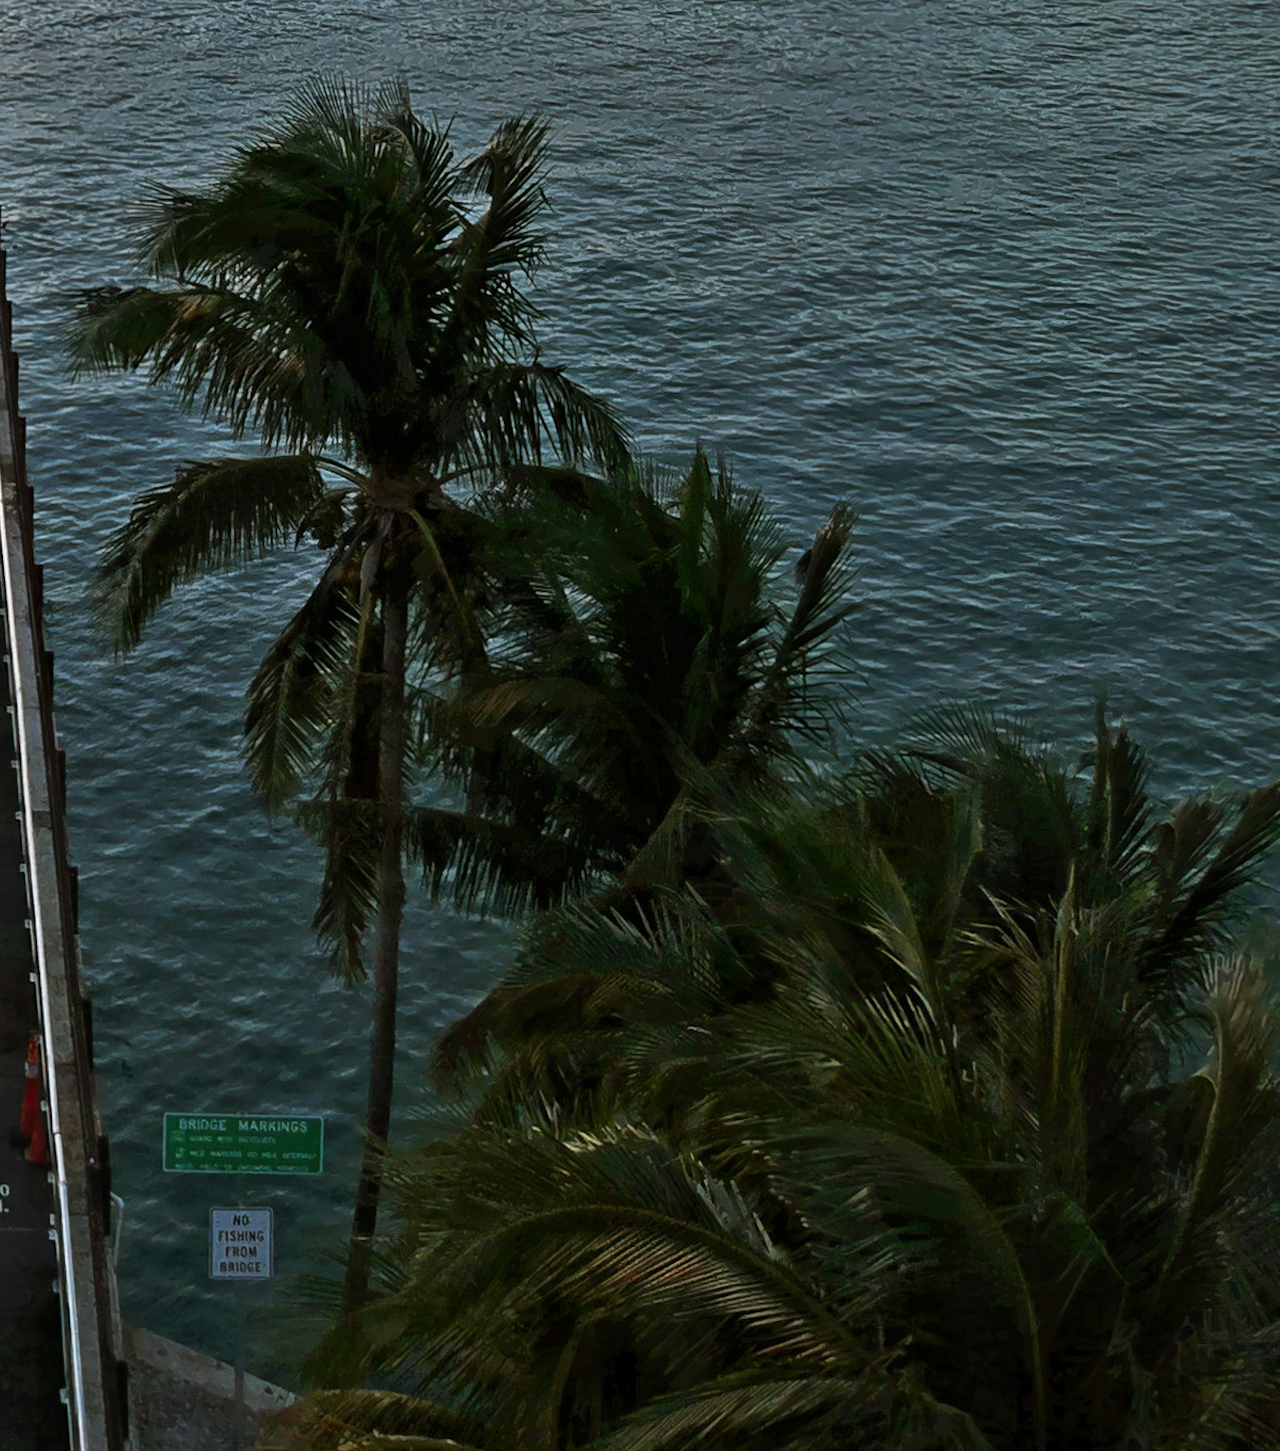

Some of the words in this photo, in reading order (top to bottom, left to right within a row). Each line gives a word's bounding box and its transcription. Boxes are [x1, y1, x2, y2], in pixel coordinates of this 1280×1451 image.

[178, 1118, 227, 1132] BRIDGE
[238, 1119, 308, 1134] MARKINGS
[232, 1213, 250, 1226] NO
[217, 1230, 265, 1243] FISHING
[225, 1246, 258, 1258] FROM
[219, 1261, 262, 1274] BRIDGE
